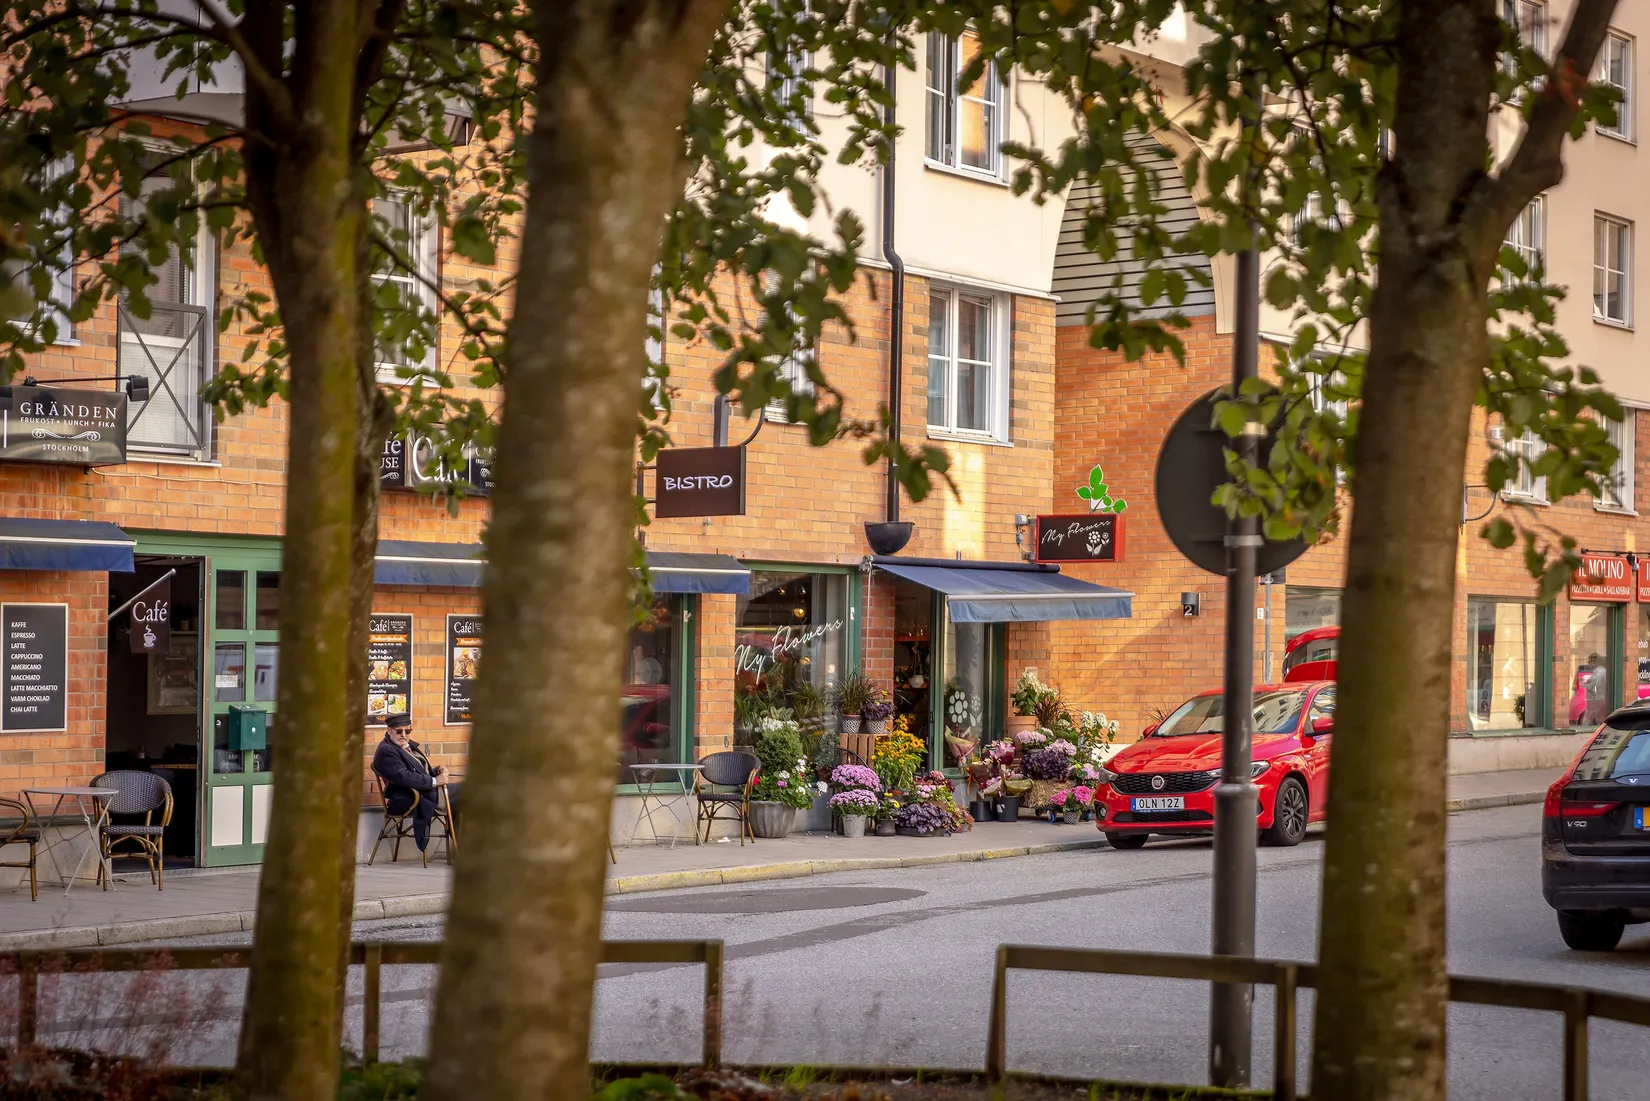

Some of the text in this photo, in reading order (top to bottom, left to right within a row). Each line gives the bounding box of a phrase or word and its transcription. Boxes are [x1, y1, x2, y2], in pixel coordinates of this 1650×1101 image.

[20, 401, 117, 419] GRÄNDEN
[42, 444, 89, 452] STOCKHOLM
[663, 474, 733, 491] BISTRO
[1041, 519, 1112, 546] My Flowers
[1578, 558, 1624, 580] IL MOLINO
[1606, 585, 1631, 595] SALLADSBAR
[132, 599, 168, 622] Café
[1184, 604, 1192, 616] 2
[368, 619, 388, 632] Café
[453, 621, 472, 634] Café
[733, 618, 844, 685] My Flowers
[1139, 798, 1180, 809] OLN 12Z
[1566, 820, 1587, 828] V90
